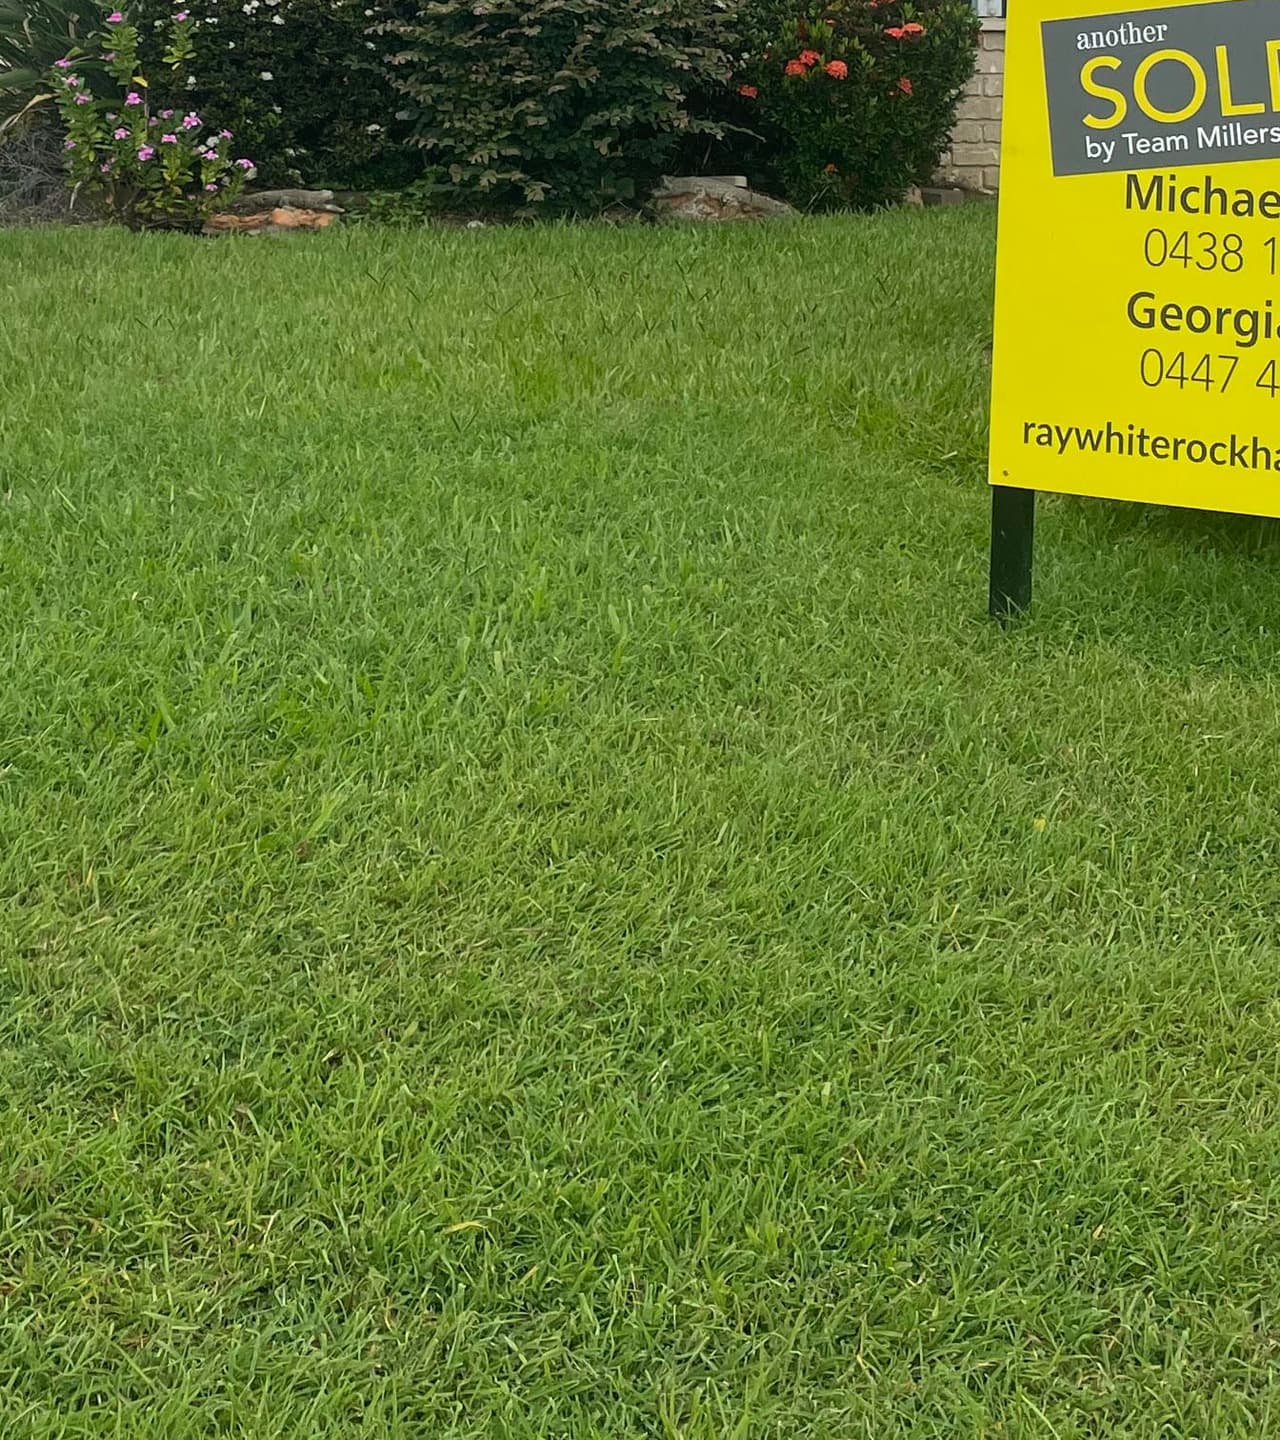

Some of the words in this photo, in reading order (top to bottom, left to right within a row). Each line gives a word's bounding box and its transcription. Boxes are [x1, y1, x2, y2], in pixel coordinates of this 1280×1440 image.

[1076, 20, 1168, 51] another
[1085, 136, 1114, 162] by
[1122, 132, 1189, 153] Team
[1144, 229, 1243, 273] 0438
[1140, 348, 1239, 393] 0447
